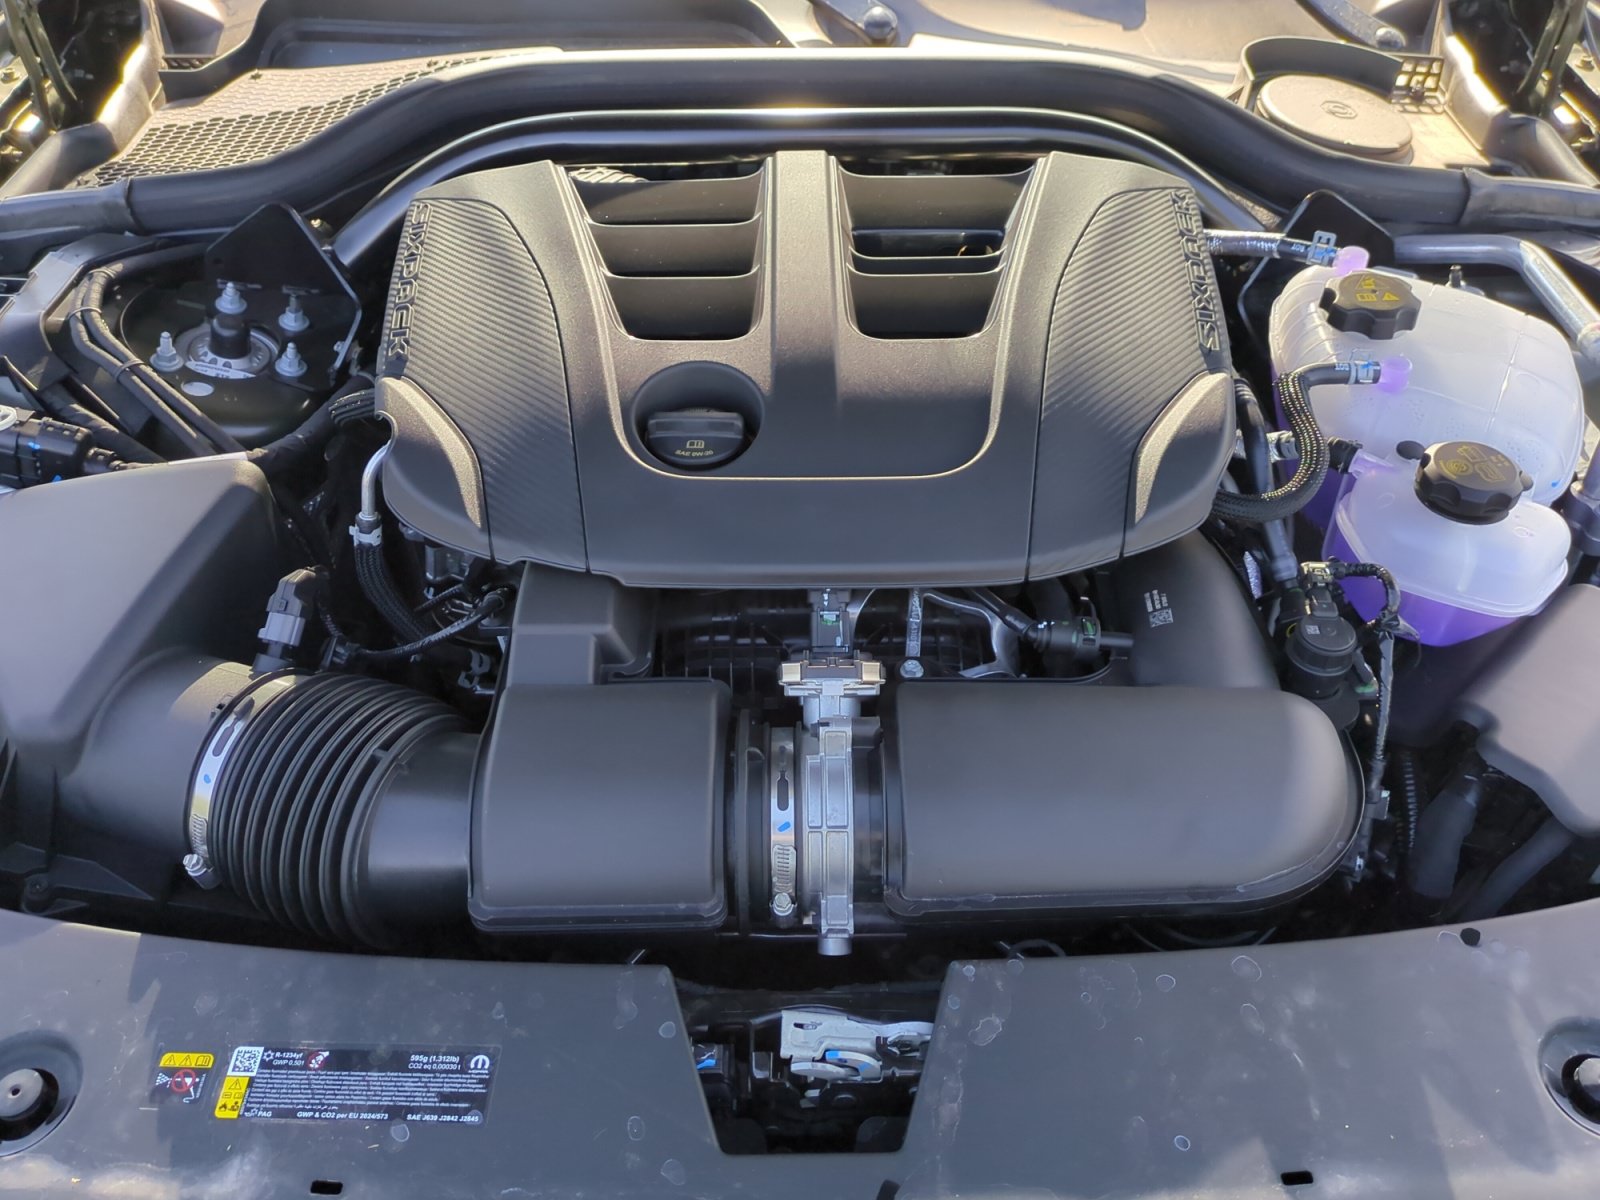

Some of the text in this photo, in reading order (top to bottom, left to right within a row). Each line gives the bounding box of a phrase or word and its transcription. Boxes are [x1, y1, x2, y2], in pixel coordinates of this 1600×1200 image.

[1170, 190, 1220, 351] SIXPACK
[388, 203, 433, 357] SIXPACK
[274, 1051, 303, 1060] R-1234yf
[410, 1054, 429, 1063] 595g
[359, 1112, 389, 1120] 2024/573
